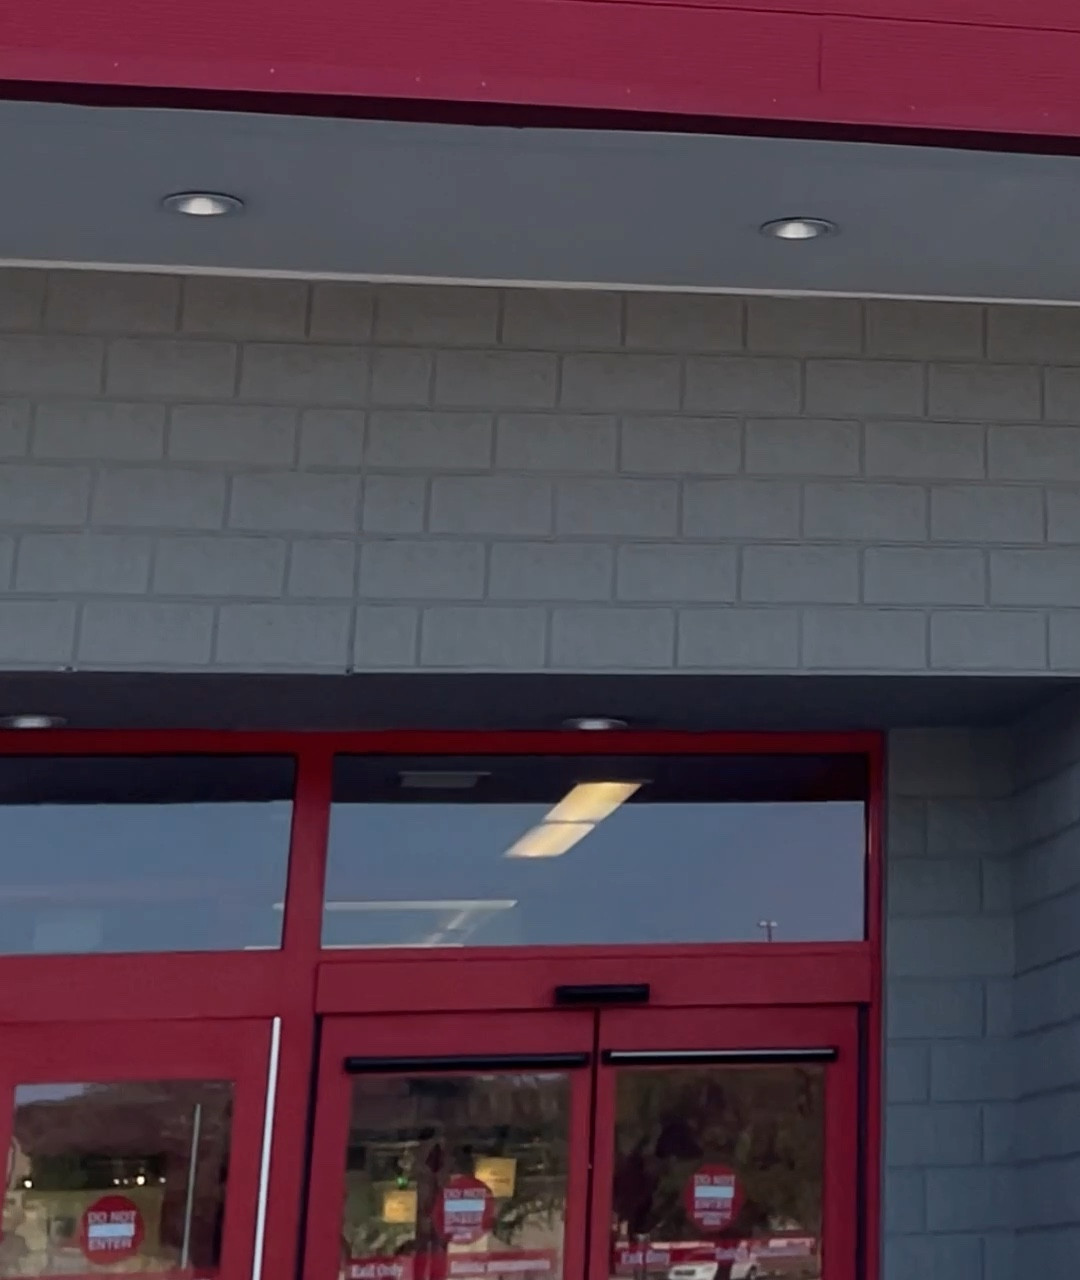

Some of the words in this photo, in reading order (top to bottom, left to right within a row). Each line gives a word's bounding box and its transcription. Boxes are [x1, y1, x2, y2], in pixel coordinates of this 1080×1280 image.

[88, 1212, 107, 1225] DO
[111, 1210, 136, 1224] NOT
[88, 1237, 132, 1251] ENTER
